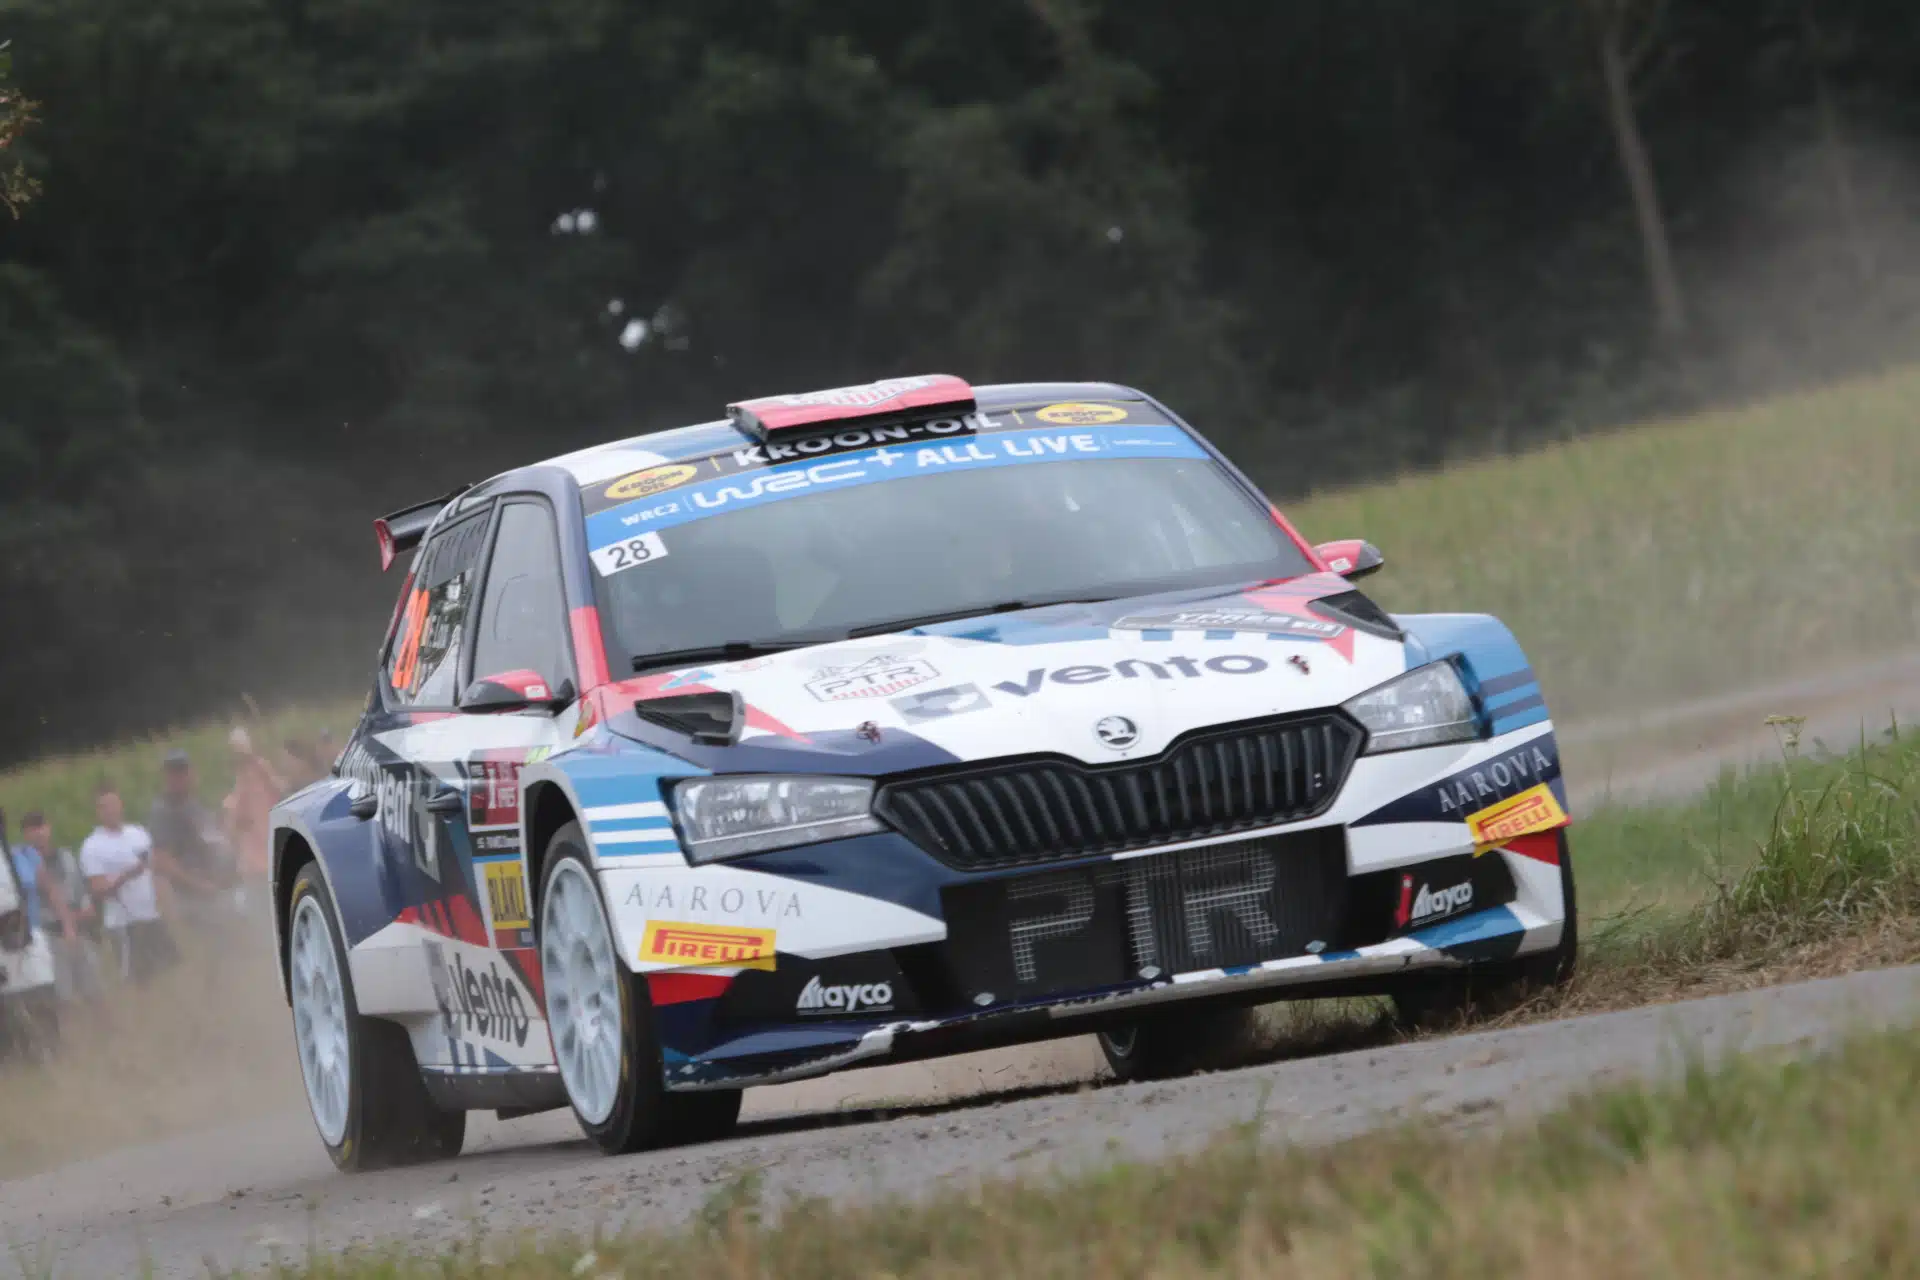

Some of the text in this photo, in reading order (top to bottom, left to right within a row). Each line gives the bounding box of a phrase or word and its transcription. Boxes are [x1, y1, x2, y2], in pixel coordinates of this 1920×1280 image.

[620, 502, 681, 527] WRC2
[916, 443, 997, 468] ALL
[1002, 434, 1101, 457] LIVE
[607, 539, 652, 570] 28
[992, 653, 1269, 698] vento
[1437, 745, 1553, 814] AAROVA
[1475, 795, 1553, 842] PIRELLI
[624, 882, 804, 918] AAROVA
[651, 928, 765, 962] PIRELLI
